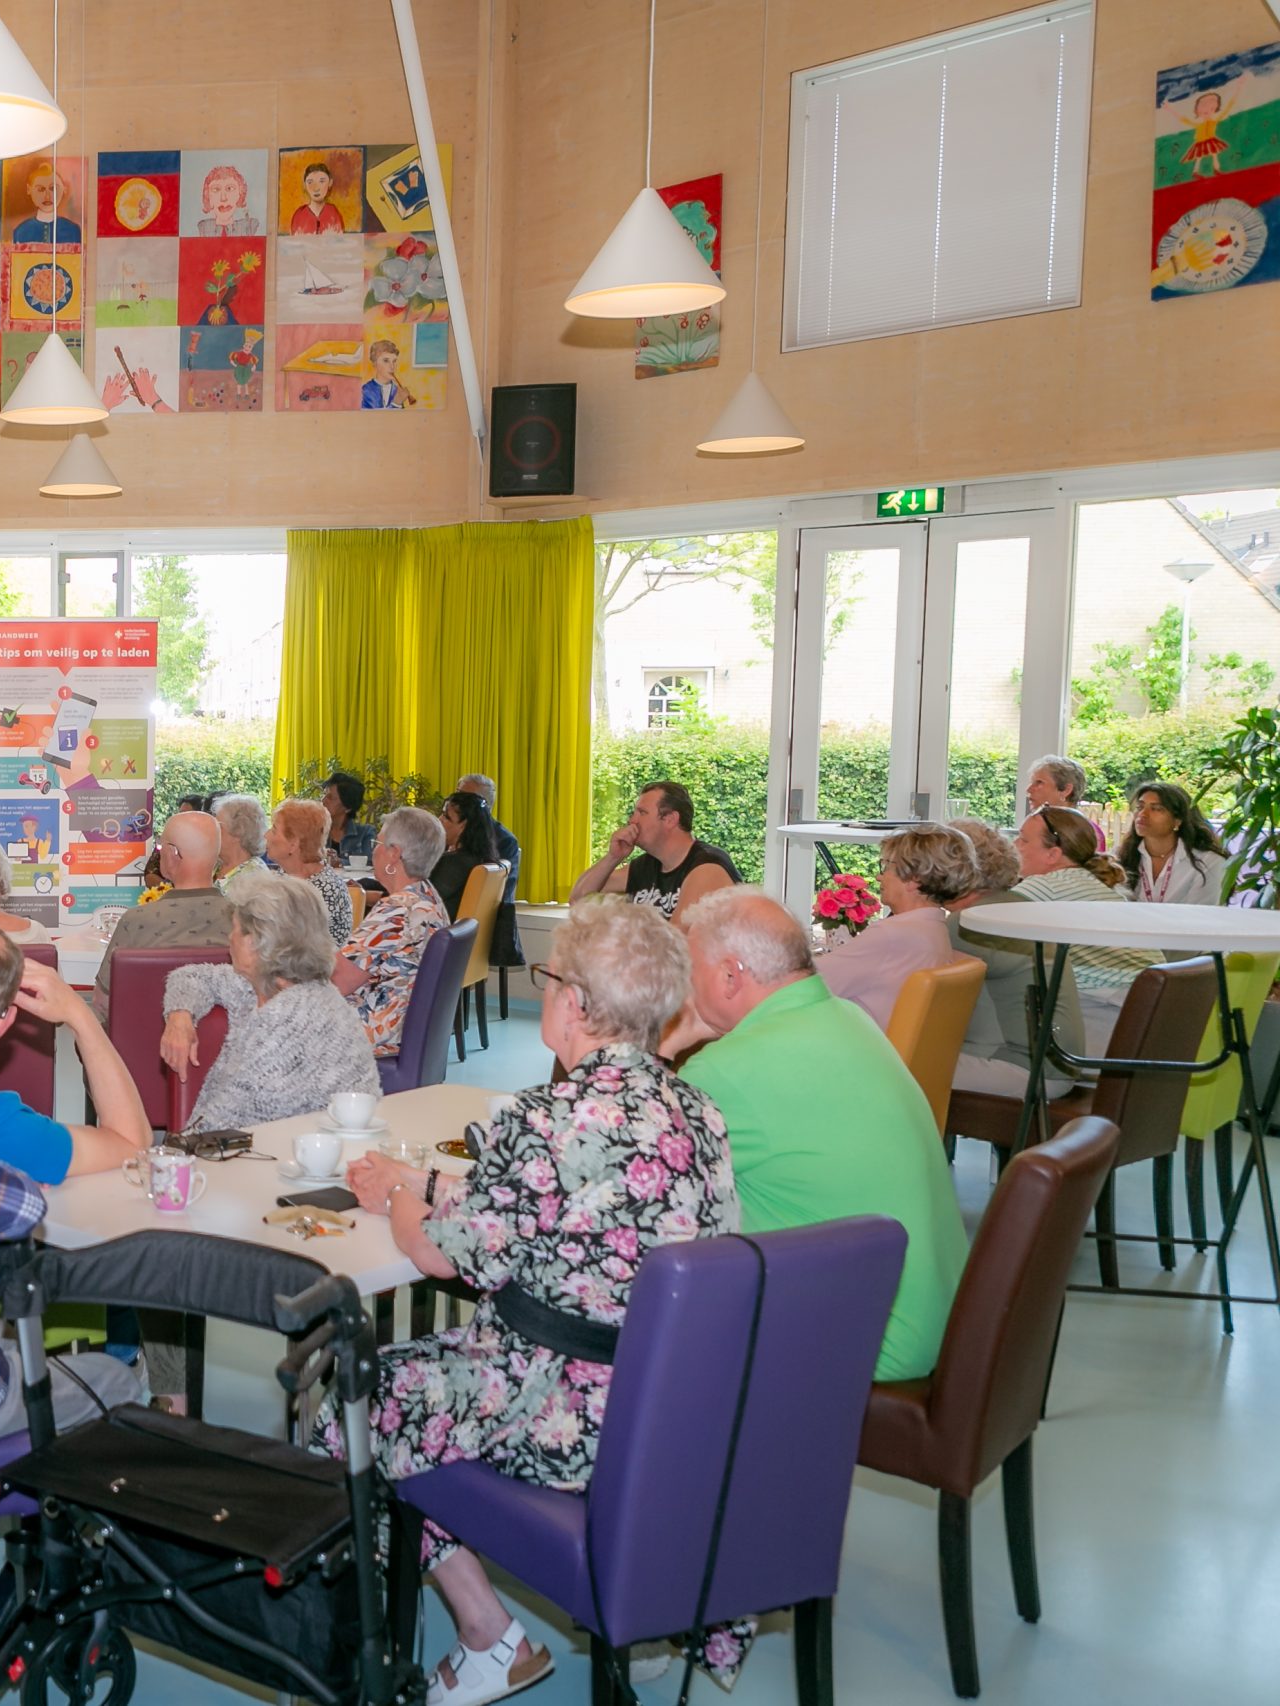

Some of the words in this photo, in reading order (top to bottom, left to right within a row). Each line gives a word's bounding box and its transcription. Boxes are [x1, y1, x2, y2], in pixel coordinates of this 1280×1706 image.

[24, 649, 42, 657] om
[46, 648, 79, 659] veilig
[83, 649, 98, 659] op
[101, 648, 113, 657] te
[117, 647, 150, 657] laden
[89, 738, 95, 746] 3
[33, 774, 44, 782] 15
